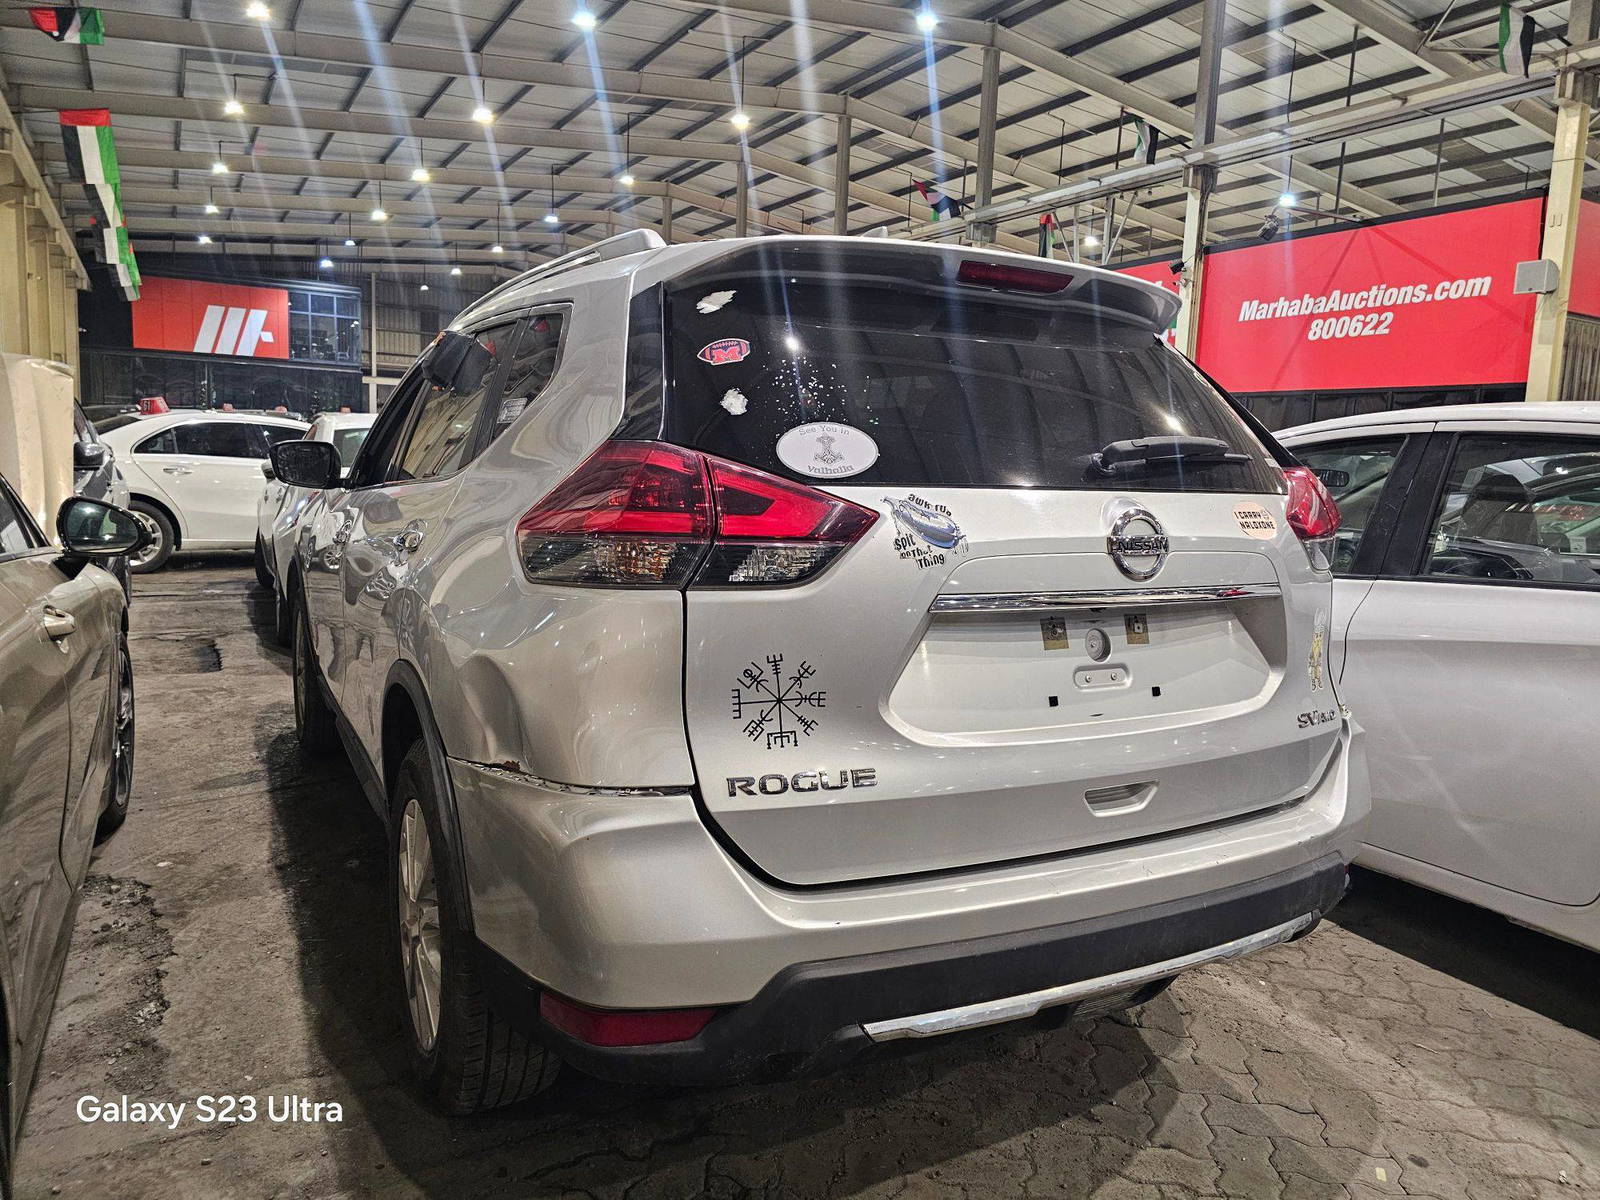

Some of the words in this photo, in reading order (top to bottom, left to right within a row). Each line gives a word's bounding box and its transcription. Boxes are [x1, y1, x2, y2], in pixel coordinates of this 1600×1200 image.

[1238, 276, 1492, 322] MarhabaAuctions.com
[1307, 311, 1394, 341] 800622
[820, 425, 837, 433] You
[1238, 511, 1262, 519] CARRY
[1239, 521, 1276, 530] NALOXONE
[1117, 540, 1169, 553] NISSAN
[726, 767, 878, 798] ROGUE
